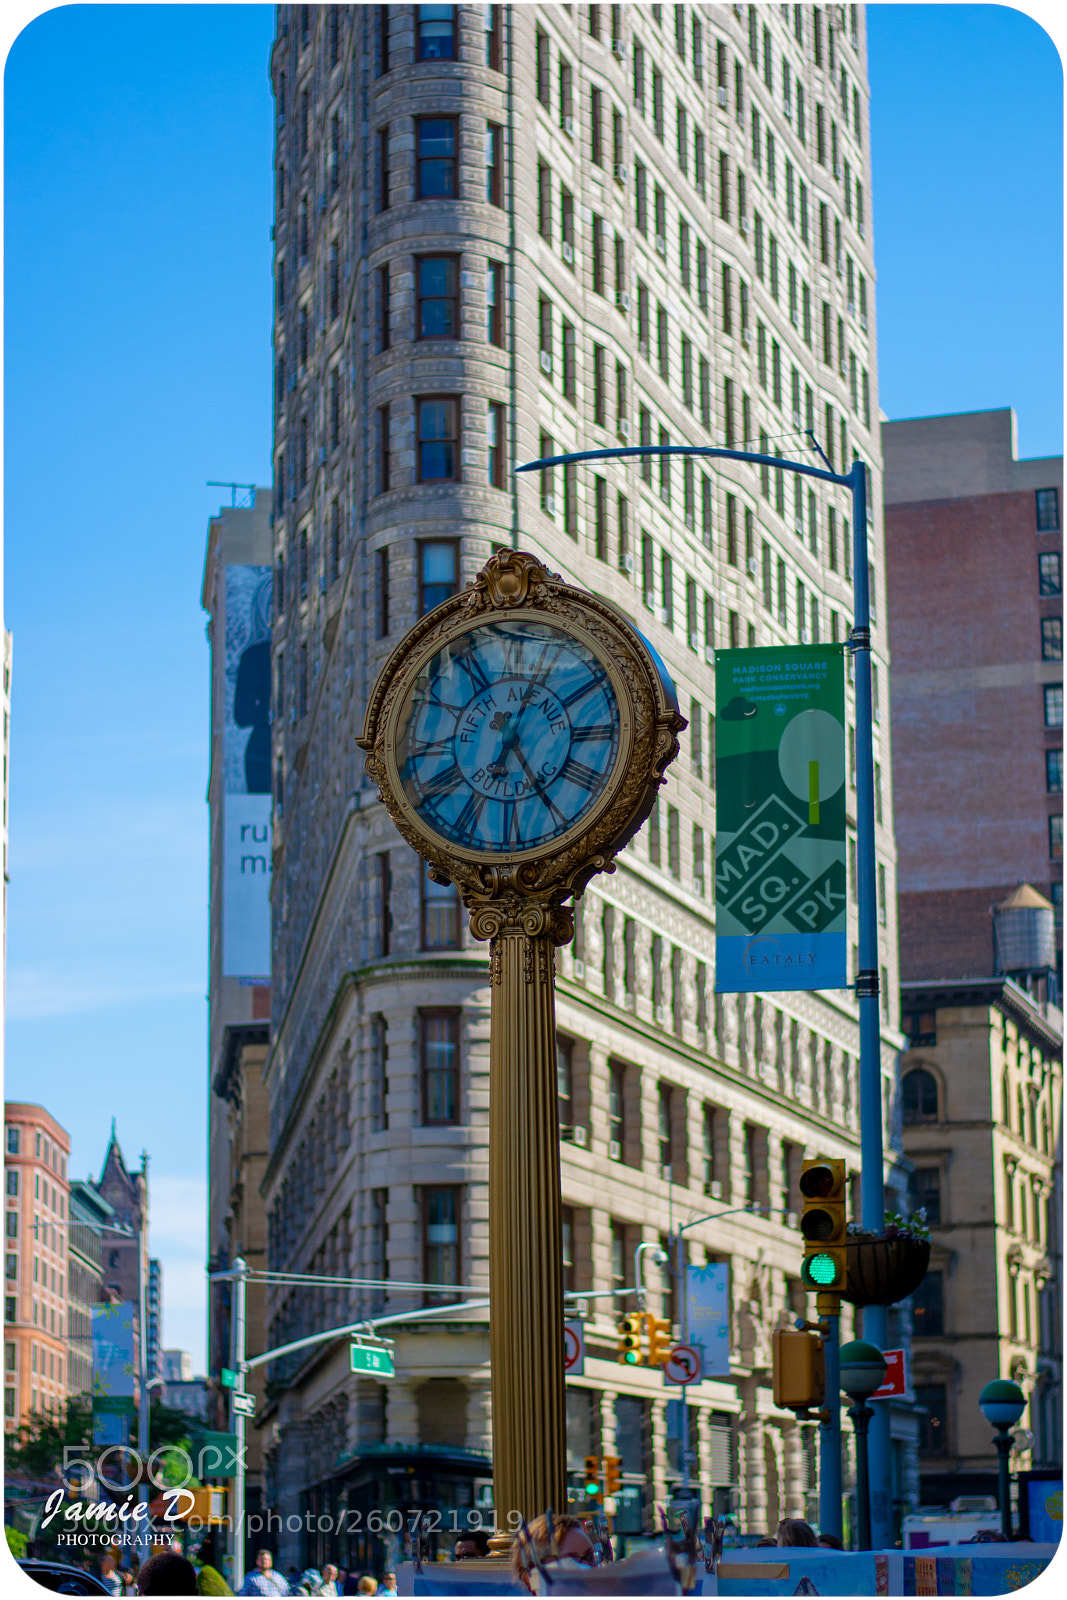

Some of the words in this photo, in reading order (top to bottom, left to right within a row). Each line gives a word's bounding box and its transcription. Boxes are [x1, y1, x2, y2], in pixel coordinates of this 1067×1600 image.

[732, 664, 781, 675] MADISON
[784, 662, 828, 671] SQUARE
[732, 675, 756, 684] PARK
[759, 673, 828, 682] CONSERVANCY
[460, 694, 498, 744] FIFTH
[506, 686, 567, 736] AVENUE
[240, 824, 268, 843] ru
[715, 821, 790, 894] MAD.
[741, 876, 799, 923] SQ.
[795, 878, 845, 928] PK
[750, 952, 816, 965] EATALY
